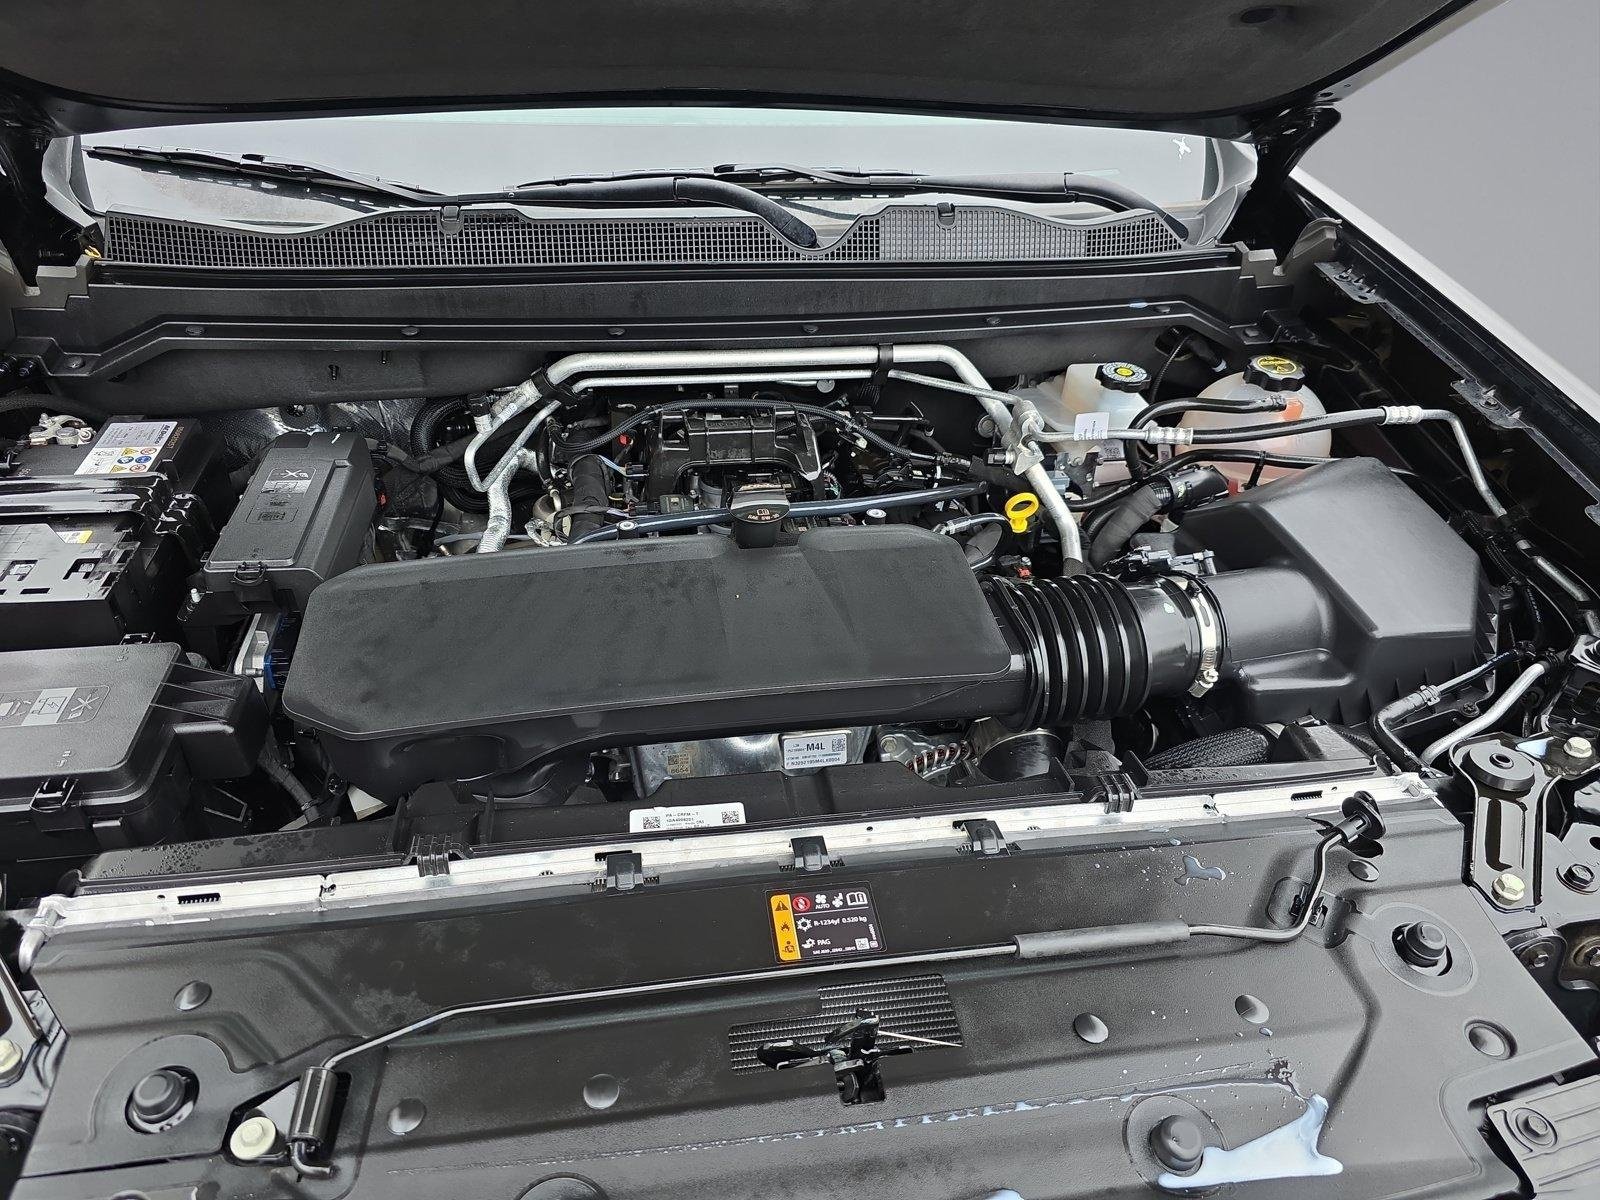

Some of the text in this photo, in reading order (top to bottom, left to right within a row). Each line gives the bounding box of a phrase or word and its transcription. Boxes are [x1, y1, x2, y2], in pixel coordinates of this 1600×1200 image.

[806, 742, 826, 752] M4L
[841, 916, 858, 924] 0.520
[859, 915, 868, 923] kg
